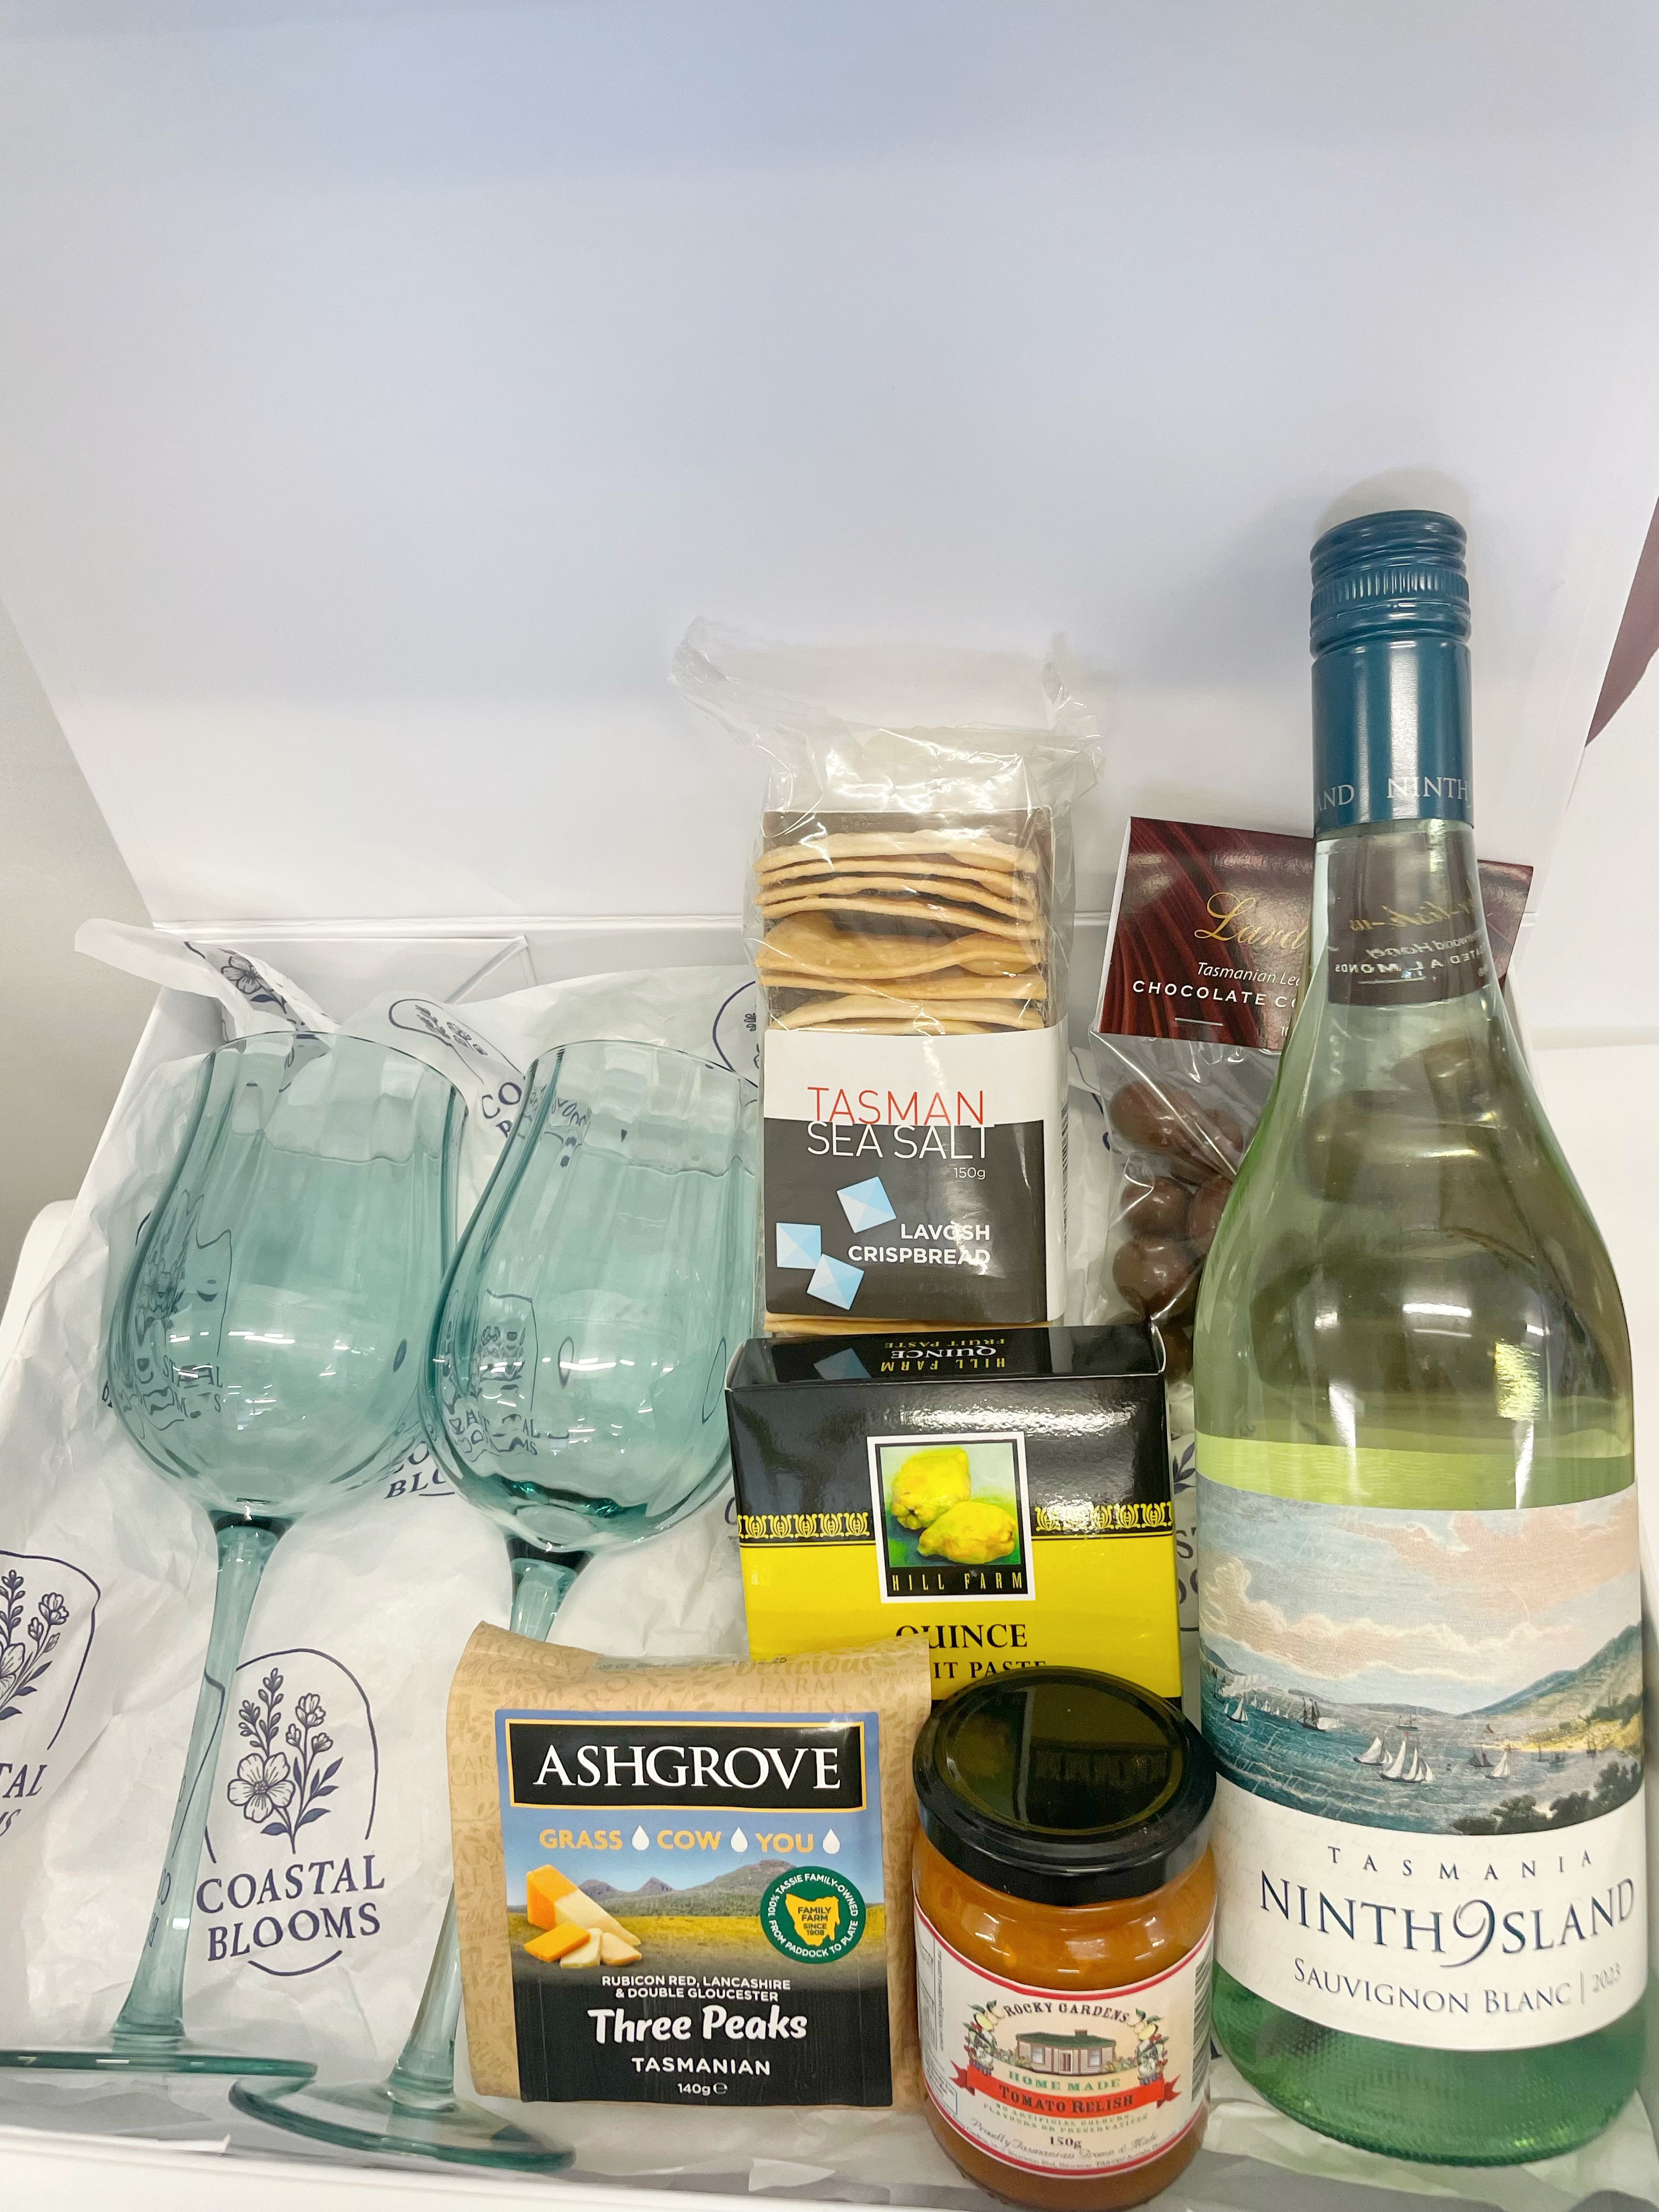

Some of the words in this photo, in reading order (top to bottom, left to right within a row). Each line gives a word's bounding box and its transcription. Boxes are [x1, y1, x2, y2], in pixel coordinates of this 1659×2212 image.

[1387, 776, 1469, 801] NINTH
[1197, 962, 1276, 984] Tasmanian
[1132, 980, 1267, 1006] CHOCOLATE
[807, 1086, 984, 1126] TASMAN
[807, 1120, 883, 1159] SEA
[893, 1122, 995, 1159] SALT
[953, 1167, 986, 1180] 150g
[901, 1223, 990, 1242] LAVOSH
[848, 1245, 991, 1265] CRISPBREAD
[890, 1345, 997, 1359] QUINCE
[881, 1360, 939, 1372] FARM
[955, 1358, 1006, 1369] HILL
[892, 1574, 944, 1591] HILL
[964, 1572, 1023, 1590] FARM
[533, 1744, 840, 1790] ASHGROVE
[539, 1829, 623, 1850] GRASS
[657, 1830, 721, 1852] COW
[755, 1833, 814, 1854] YOU
[1328, 1845, 1592, 1881] TASMANIA
[195, 1854, 386, 1915] COASTAL
[768, 1894, 780, 1917] 100%
[775, 1874, 804, 1895] TASSIE
[804, 1873, 859, 1917] FAMILY-OWNED
[206, 1901, 381, 1962] BLOOMS
[769, 1920, 787, 1944] FROM
[785, 1942, 829, 1958] PADDOCK
[828, 1943, 842, 1954] TO
[840, 1920, 859, 1946] PLATE
[602, 1976, 665, 1987] RUBICON
[668, 1976, 700, 1988] RED,
[703, 1976, 791, 1991] LANCASHIRE
[615, 1988, 625, 1999] &
[628, 1988, 685, 1999] DOUBLE
[687, 1989, 778, 2002] GLOUCESTER
[1003, 2002, 1052, 2017] ROCKY
[1058, 2002, 1130, 2023] GARDENS
[587, 2007, 692, 2044] Three
[702, 2004, 808, 2040] Peaks
[631, 2057, 770, 2076] TASMANIAN
[677, 2082, 712, 2097] 140g
[1009, 2070, 1060, 2090] HOME
[1067, 2078, 1120, 2091] MADE
[998, 2084, 1066, 2112] TOMATO
[1072, 2094, 1133, 2114] RELISH
[1048, 2135, 1082, 2149] 150g
